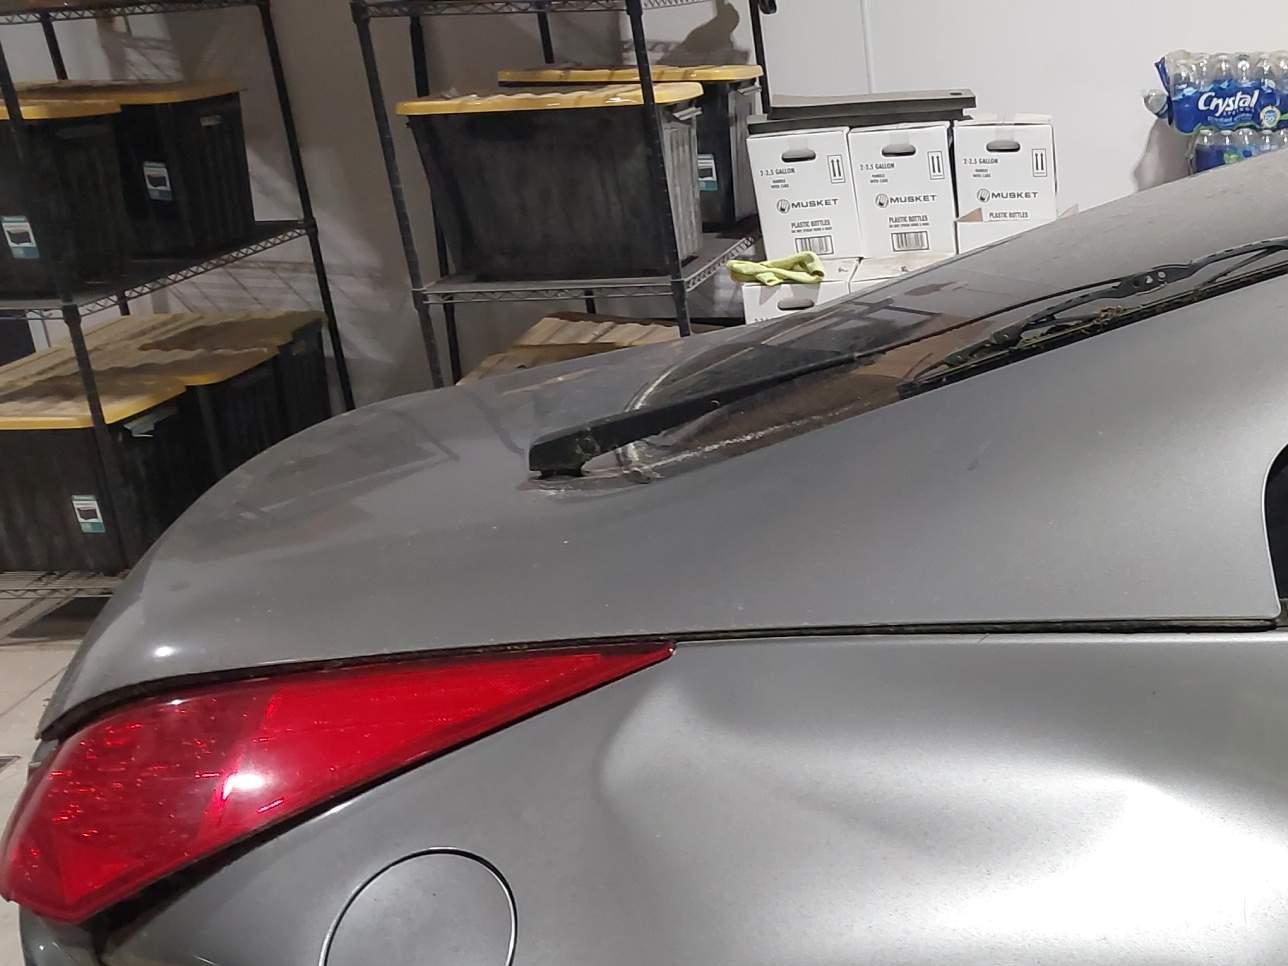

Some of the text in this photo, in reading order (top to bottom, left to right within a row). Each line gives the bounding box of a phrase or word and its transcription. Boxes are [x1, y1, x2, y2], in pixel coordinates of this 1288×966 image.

[1198, 89, 1260, 117] Crystal
[890, 194, 937, 204] MUSKET
[991, 191, 1039, 199] MUSKET
[791, 198, 839, 209] MUSKET
[791, 219, 831, 229] PLASTIC BOTTLES
